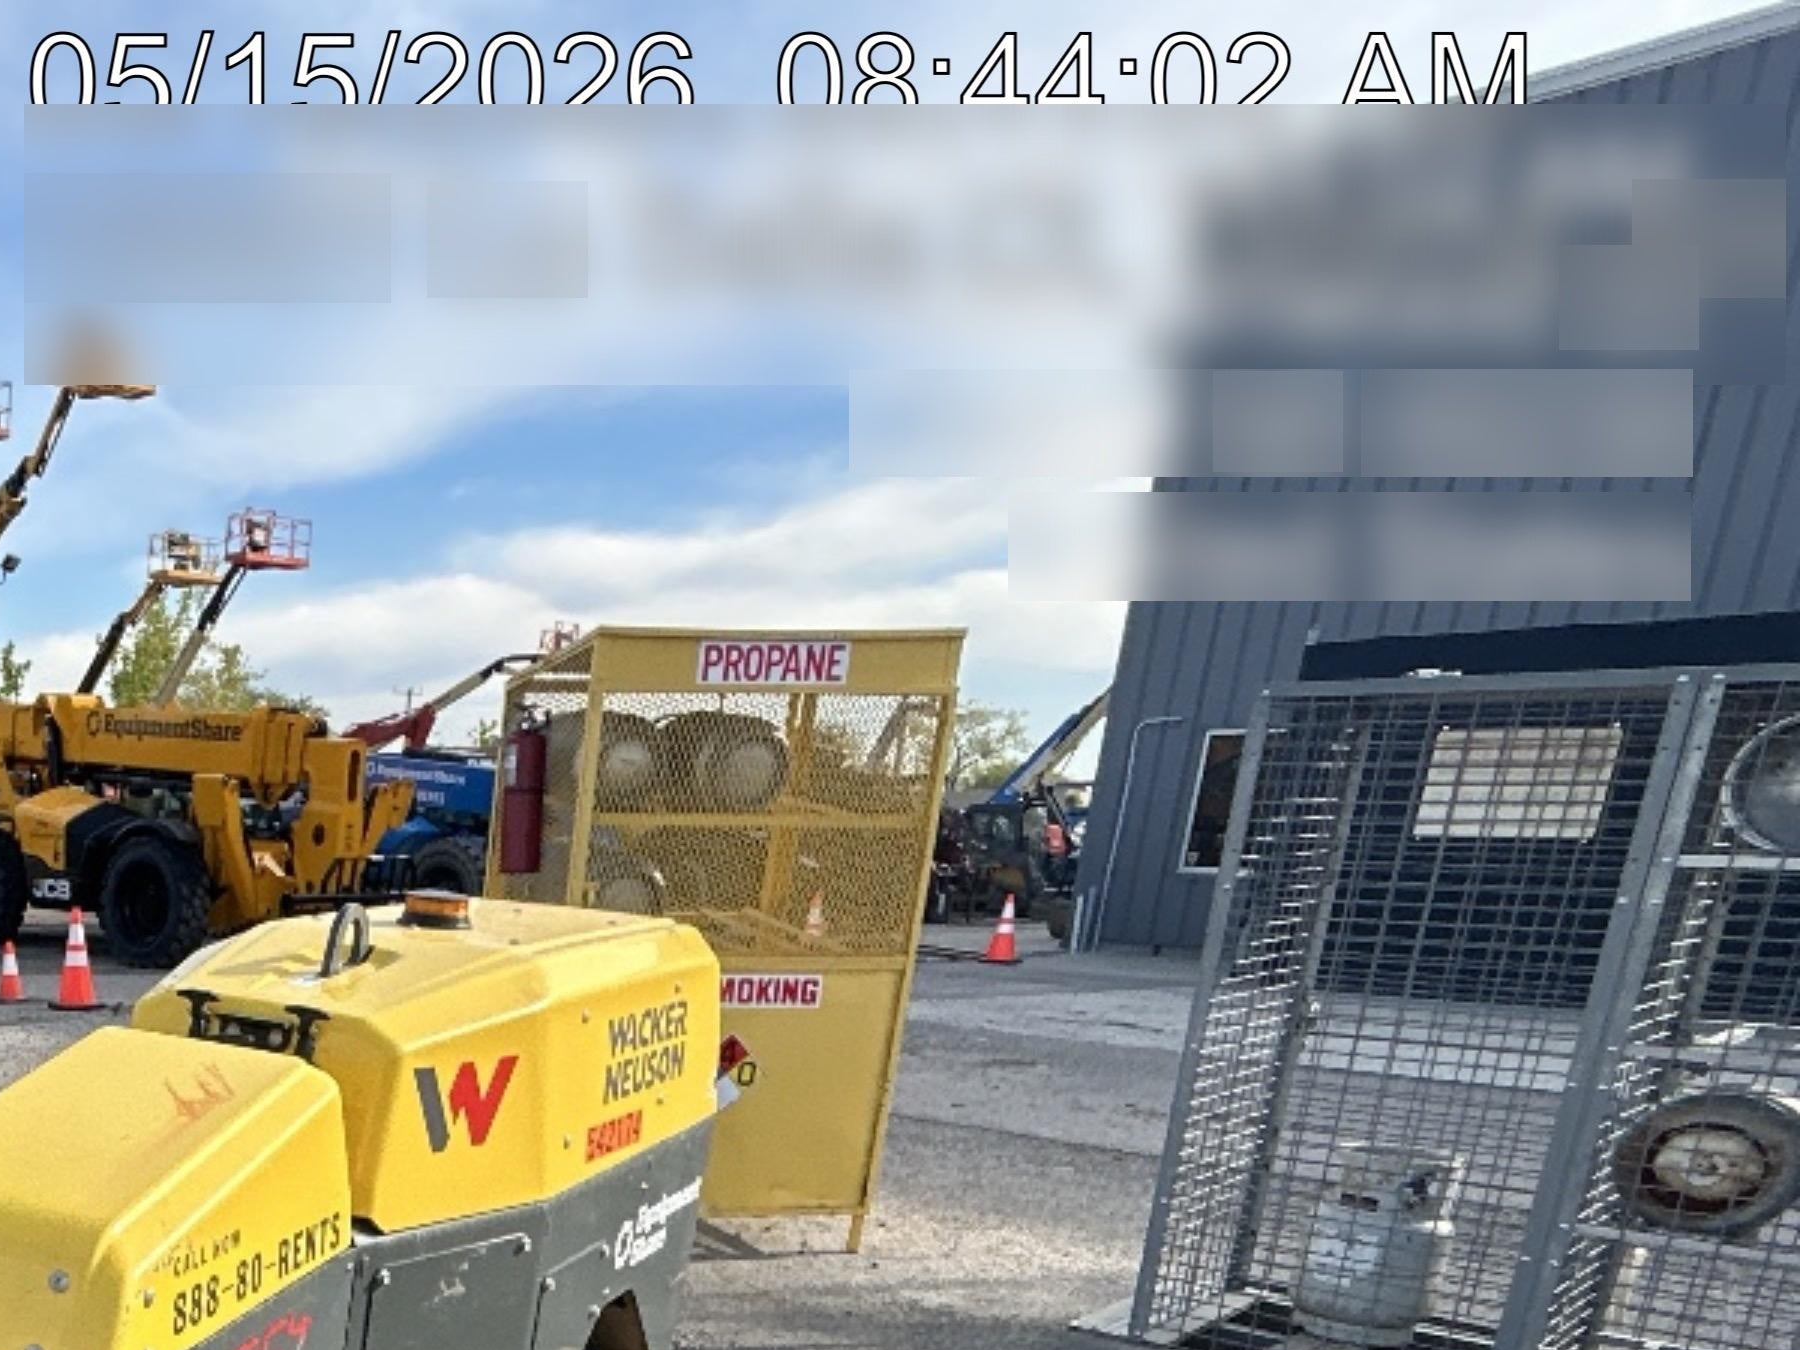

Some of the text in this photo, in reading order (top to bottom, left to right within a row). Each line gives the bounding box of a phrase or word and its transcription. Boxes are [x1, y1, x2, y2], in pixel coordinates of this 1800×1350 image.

[701, 644, 847, 682] PROPANE
[103, 713, 243, 742] EquipmentShare
[32, 878, 71, 901] JCB
[720, 977, 820, 1006] MOKING
[608, 1001, 688, 1056] WACKER
[603, 1042, 686, 1105] NEUSON
[737, 1061, 757, 1087] 0
[173, 1246, 208, 1278] CALL
[173, 1212, 341, 1336] 888-80-RENTS
